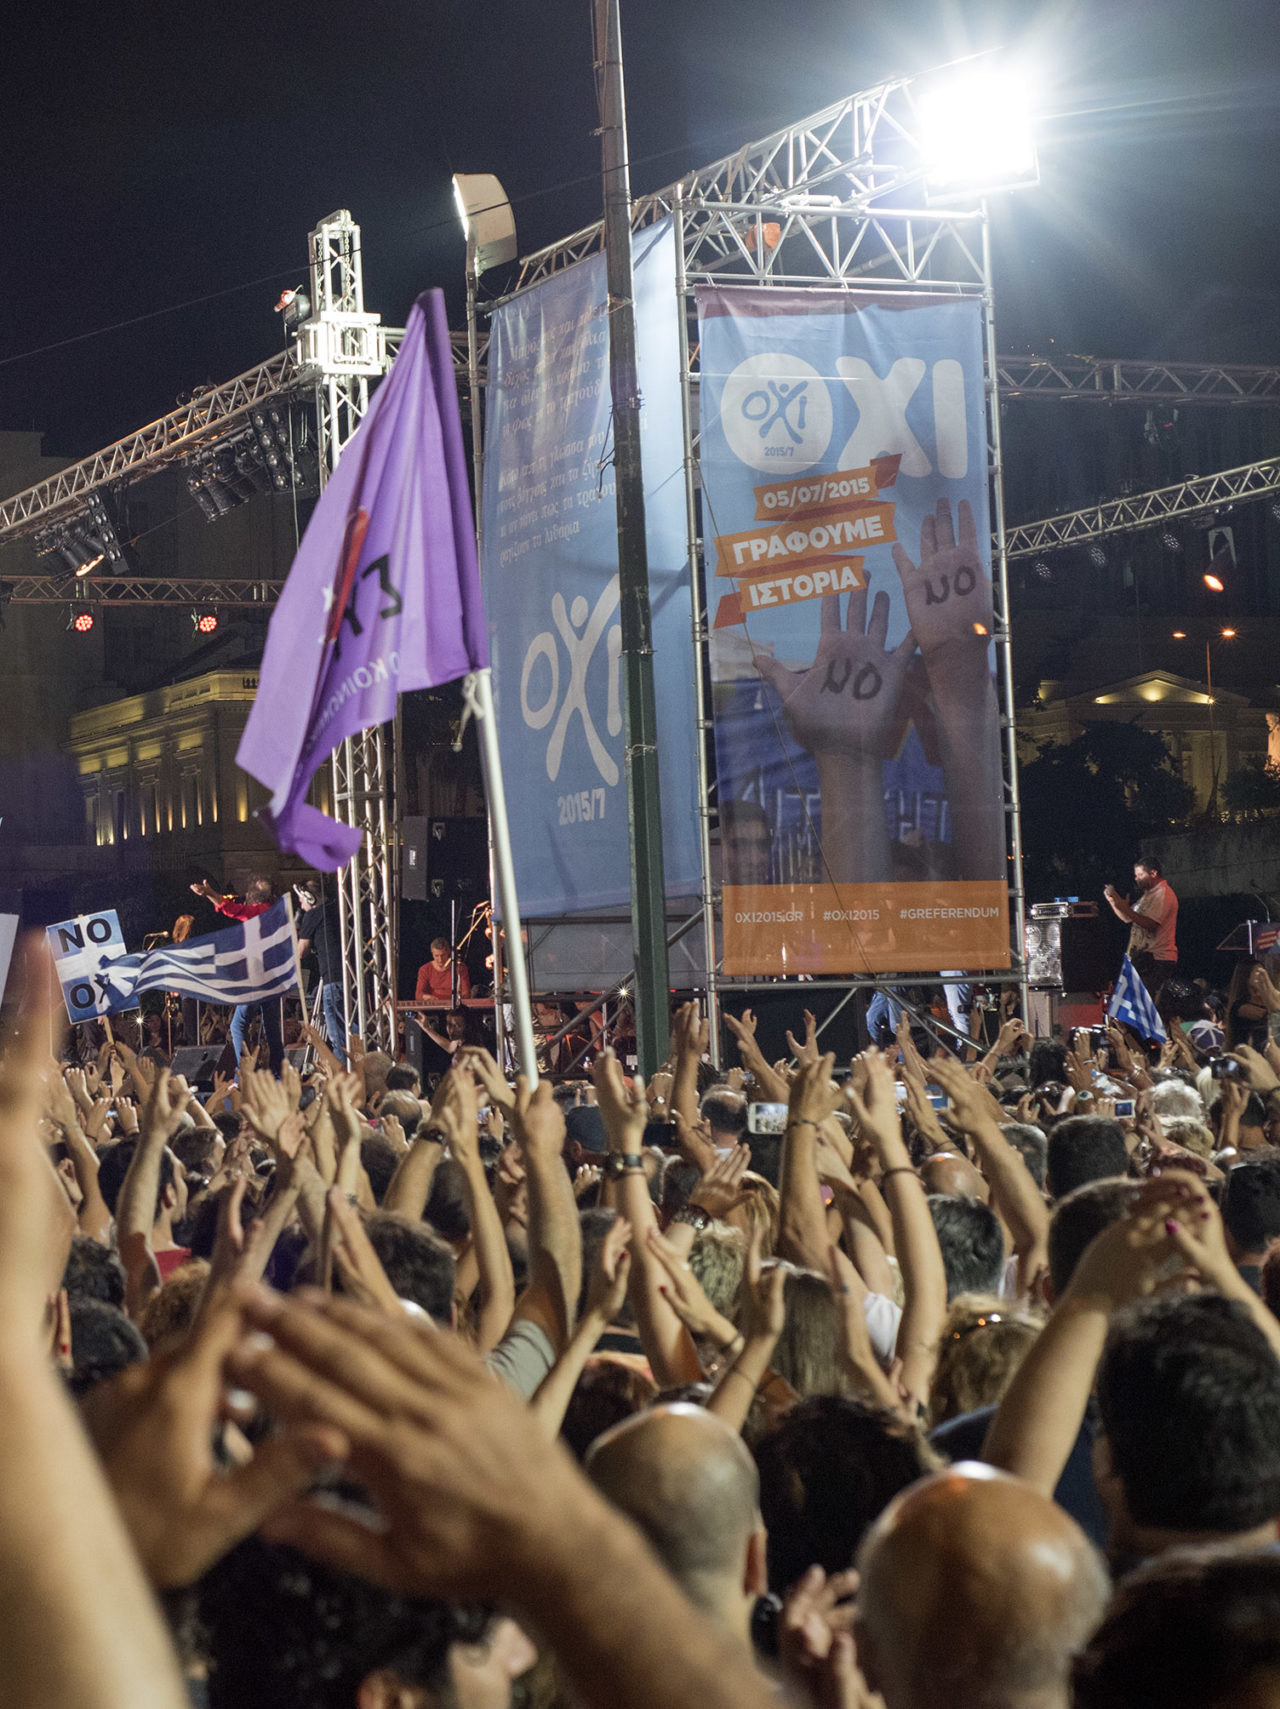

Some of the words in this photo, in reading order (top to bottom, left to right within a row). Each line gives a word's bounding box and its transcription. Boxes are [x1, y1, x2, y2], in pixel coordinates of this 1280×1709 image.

[764, 446, 795, 458] 2015/7
[763, 477, 871, 509] 05/07/2015
[732, 515, 885, 565] ΓΡΑΦΟΥΜΕ
[748, 566, 861, 607] ΙΣΤΟΡΙΑ
[557, 787, 606, 826] 2015/7
[823, 908, 880, 922] #OXI2015
[899, 907, 1000, 920] #GREFERENDUM
[57, 918, 112, 952] NO
